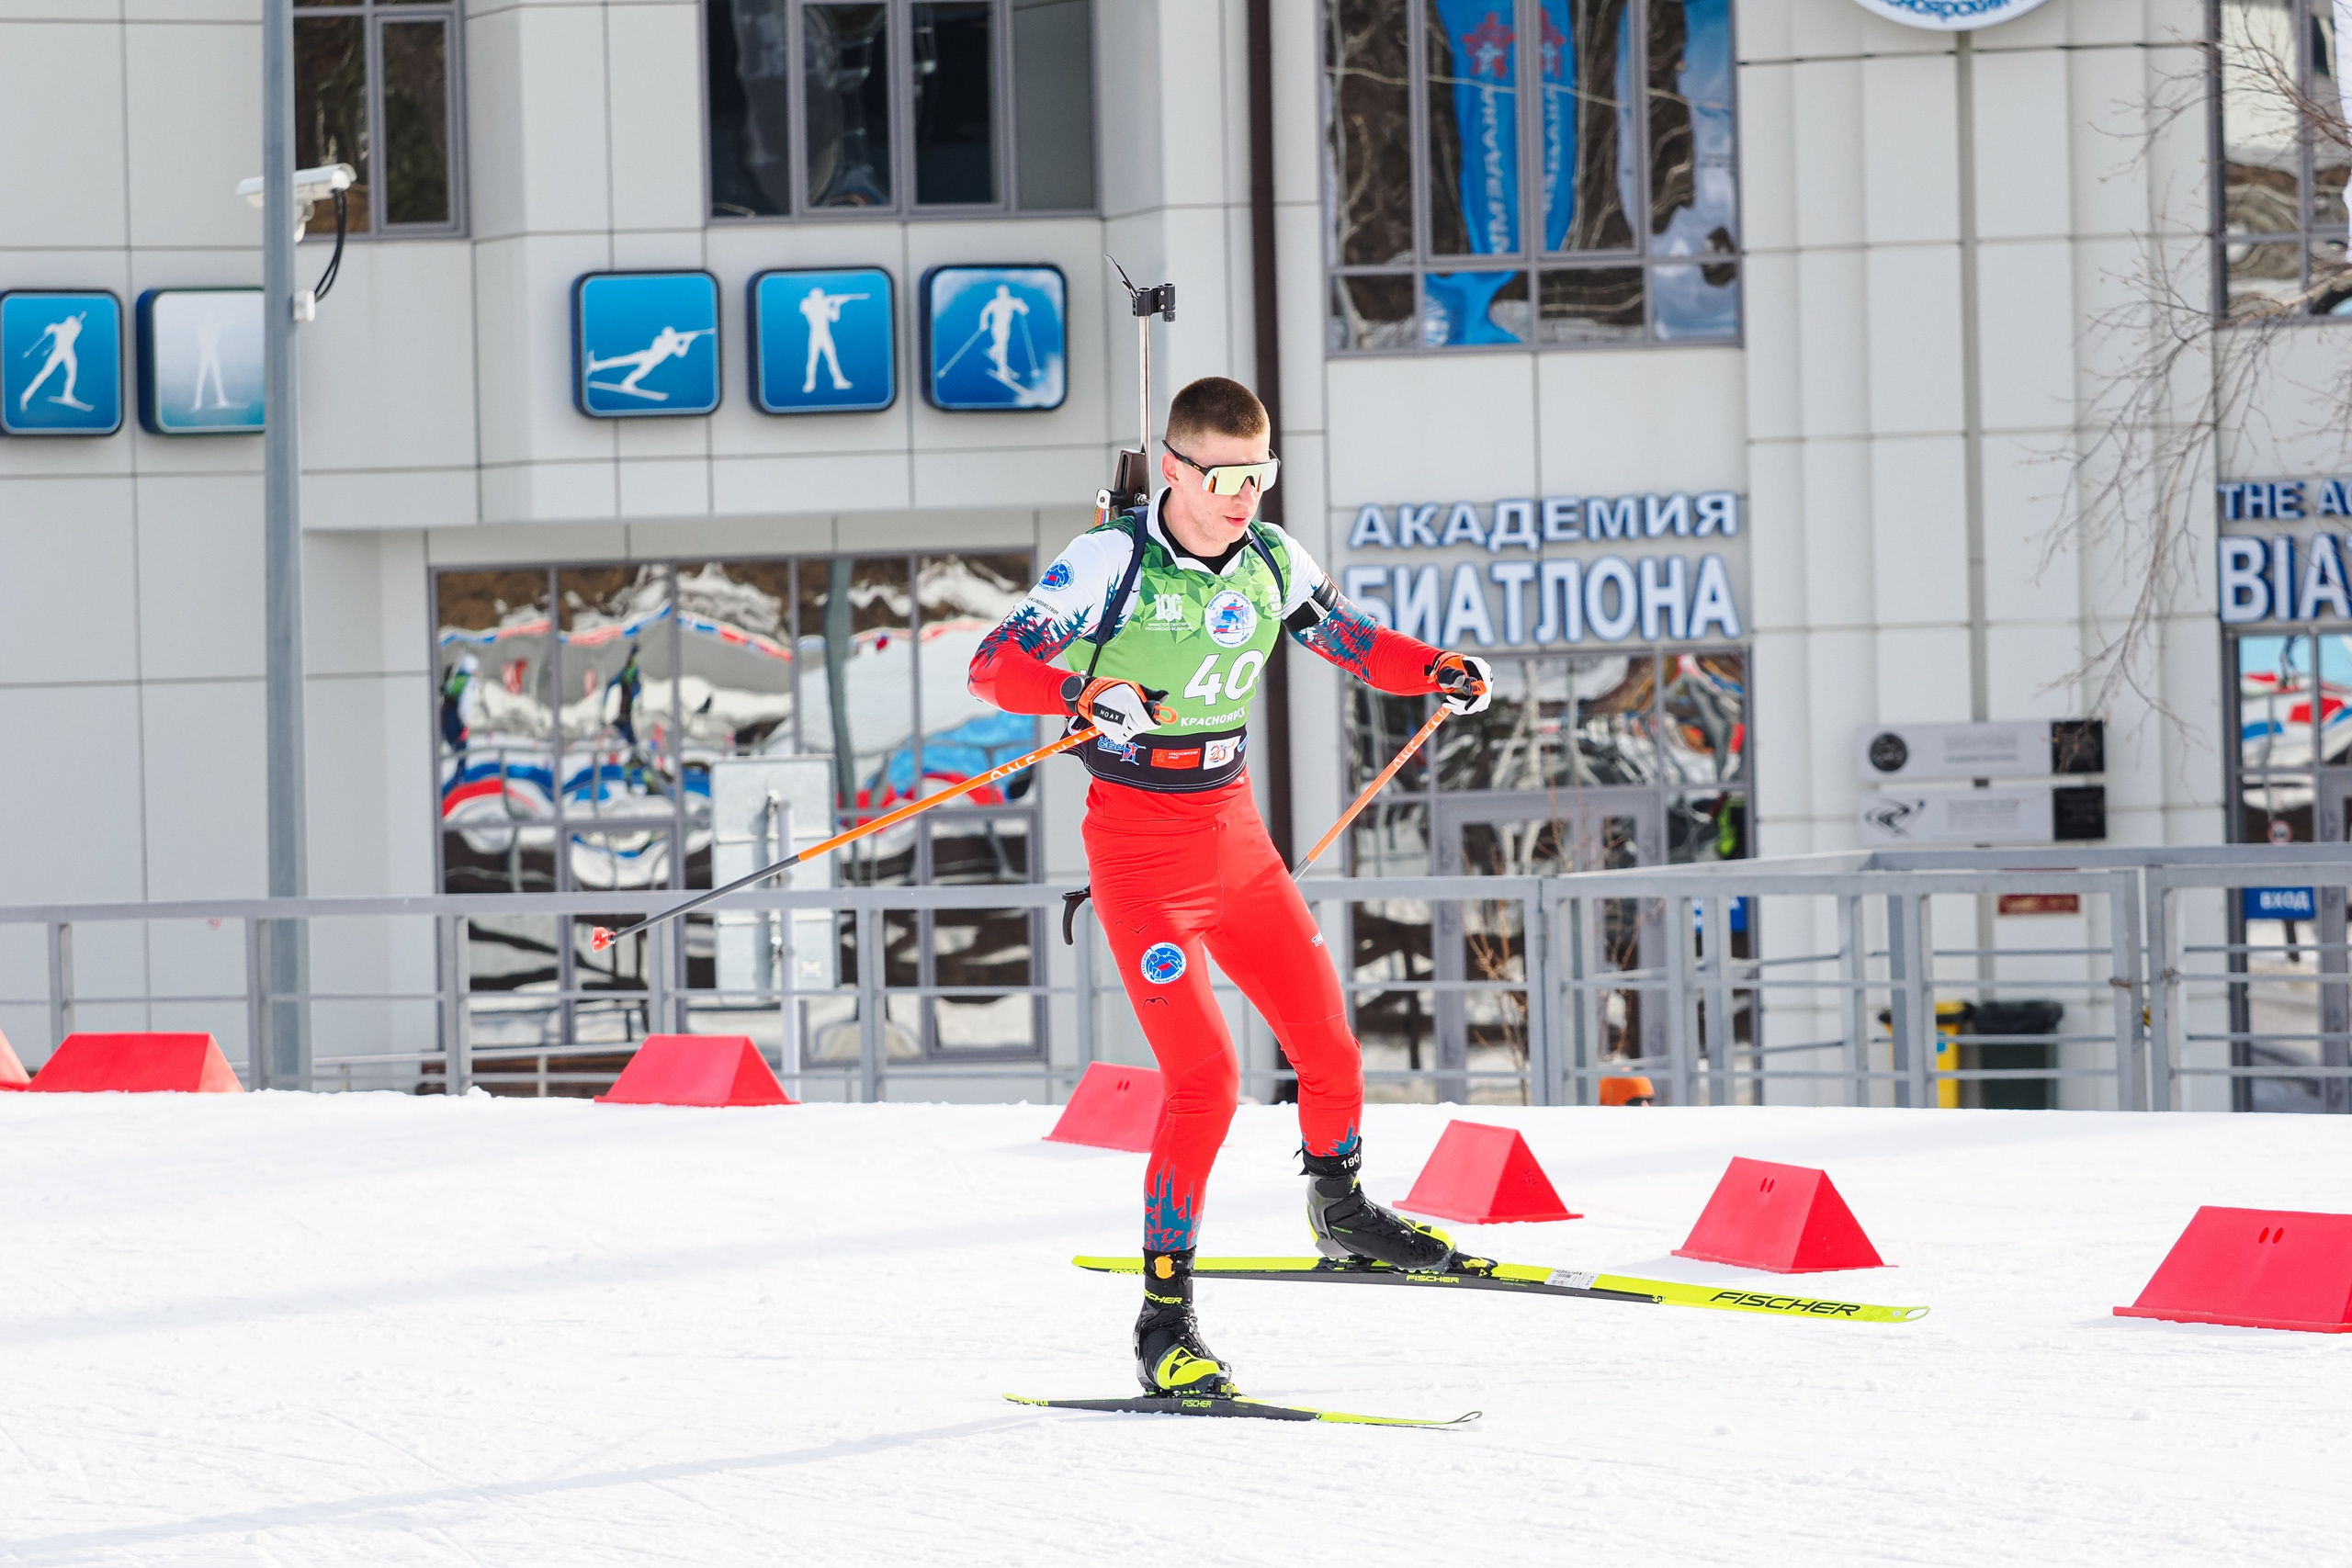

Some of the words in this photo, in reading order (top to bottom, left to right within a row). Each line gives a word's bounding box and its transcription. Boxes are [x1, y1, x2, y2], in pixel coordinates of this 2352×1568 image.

[2217, 480, 2305, 521] THE
[1348, 491, 1738, 552] АКАДЕМИЯ
[2219, 533, 2352, 623] BIA
[1344, 555, 1741, 646] БИАТЛОНА
[1182, 649, 1265, 706] 40
[1181, 705, 1246, 727] КРАСНОЯРСК
[2259, 890, 2311, 911] ВХОД
[1407, 1275, 1460, 1283] FISCHER
[1144, 1289, 1182, 1304] SCHER
[1709, 1292, 1861, 1316] FISCHER
[1182, 1399, 1213, 1408] FISCHER
